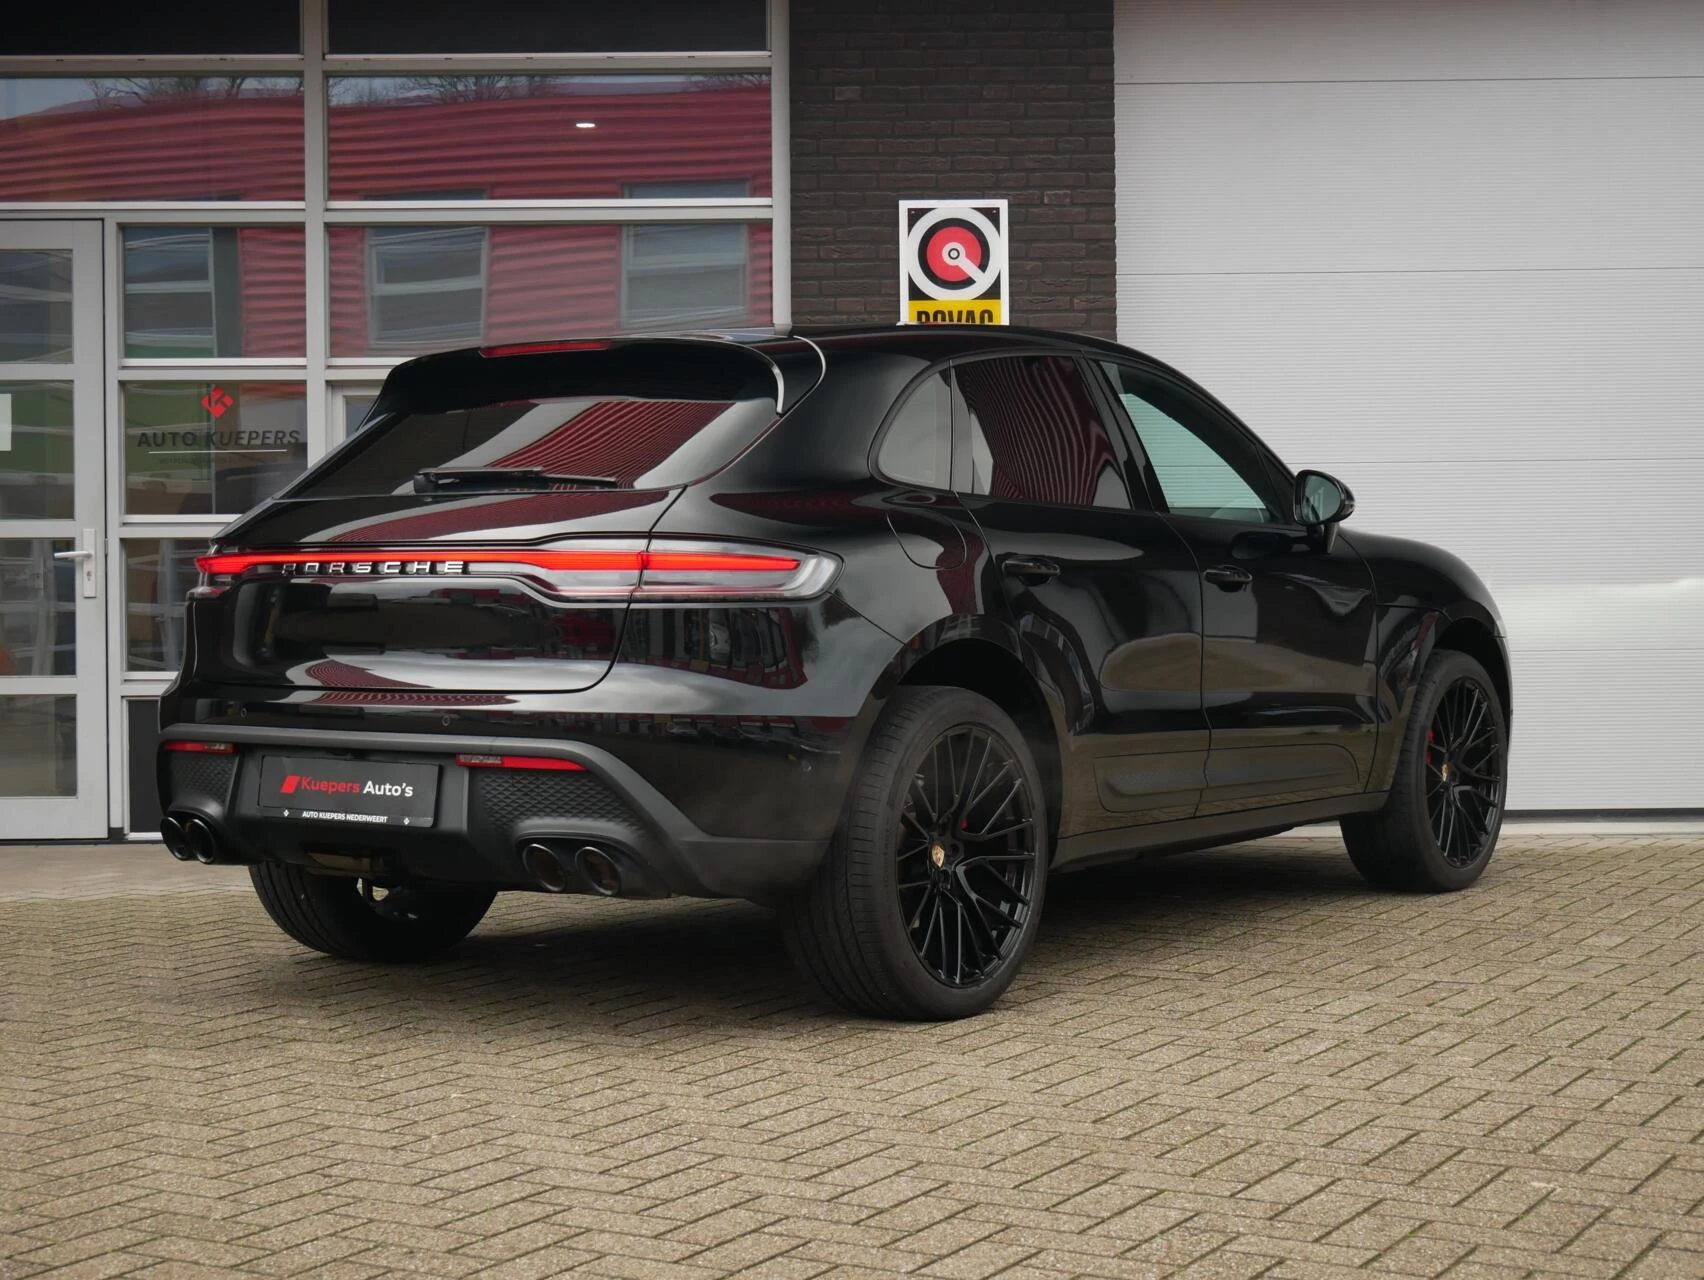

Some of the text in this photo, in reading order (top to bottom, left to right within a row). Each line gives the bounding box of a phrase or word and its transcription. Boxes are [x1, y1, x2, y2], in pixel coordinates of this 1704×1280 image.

[137, 430, 301, 447] AUTO KUEPERS
[281, 561, 465, 576] PORSCHE
[301, 776, 414, 797] Kuepers Auto's
[302, 810, 388, 823] AUTO KUEPERS NEDERWEERT
